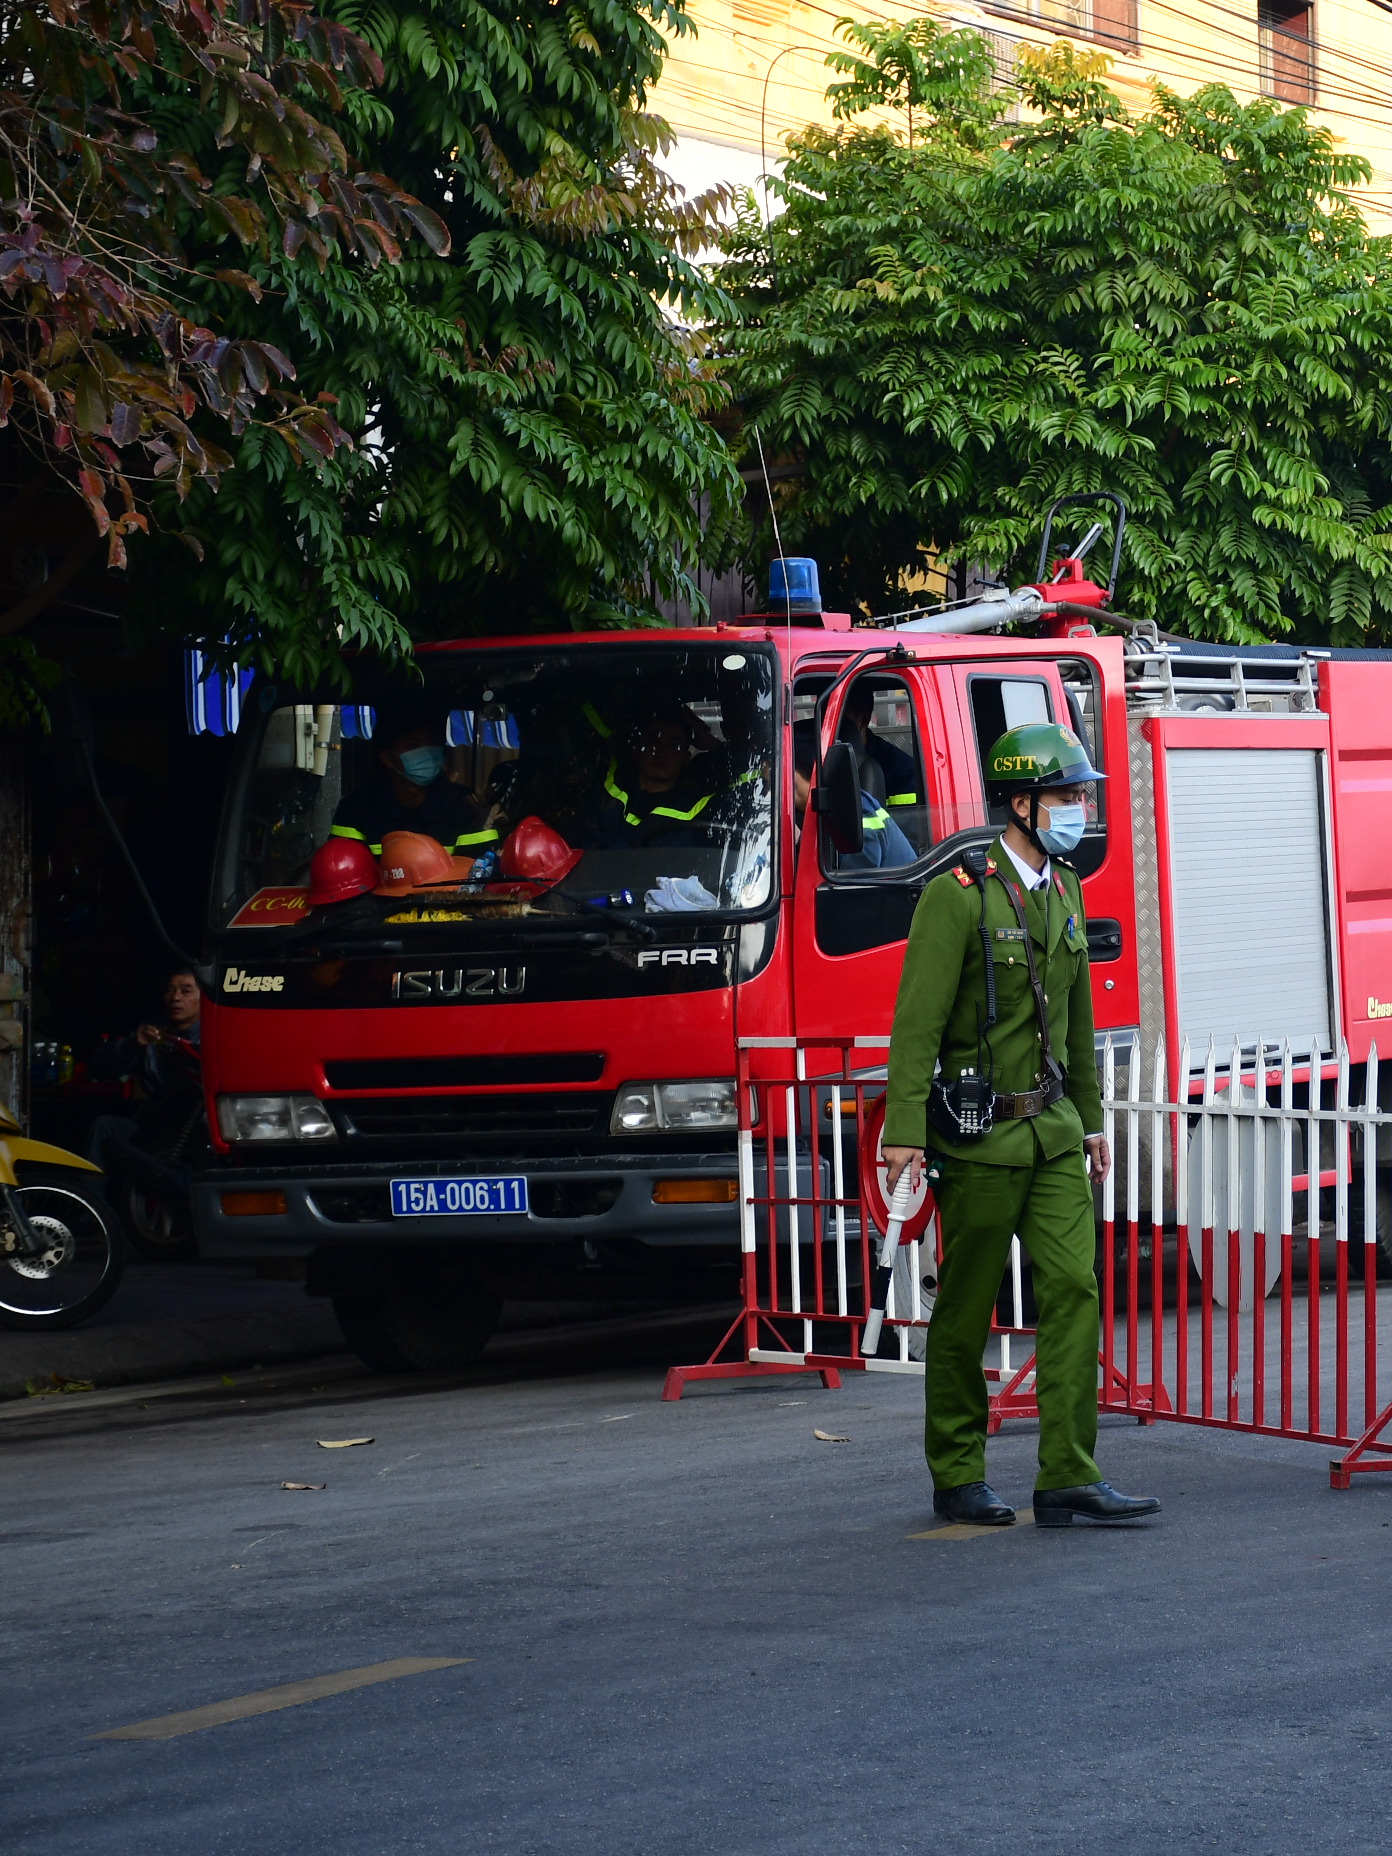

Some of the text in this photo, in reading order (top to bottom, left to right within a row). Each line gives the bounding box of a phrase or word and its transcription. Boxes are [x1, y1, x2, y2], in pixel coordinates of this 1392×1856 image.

[994, 755, 1037, 772] CSTT
[637, 948, 718, 968] FRR
[222, 967, 285, 993] Chase
[391, 966, 526, 999] ISUZU
[398, 1180, 521, 1212] 15A-006.11
